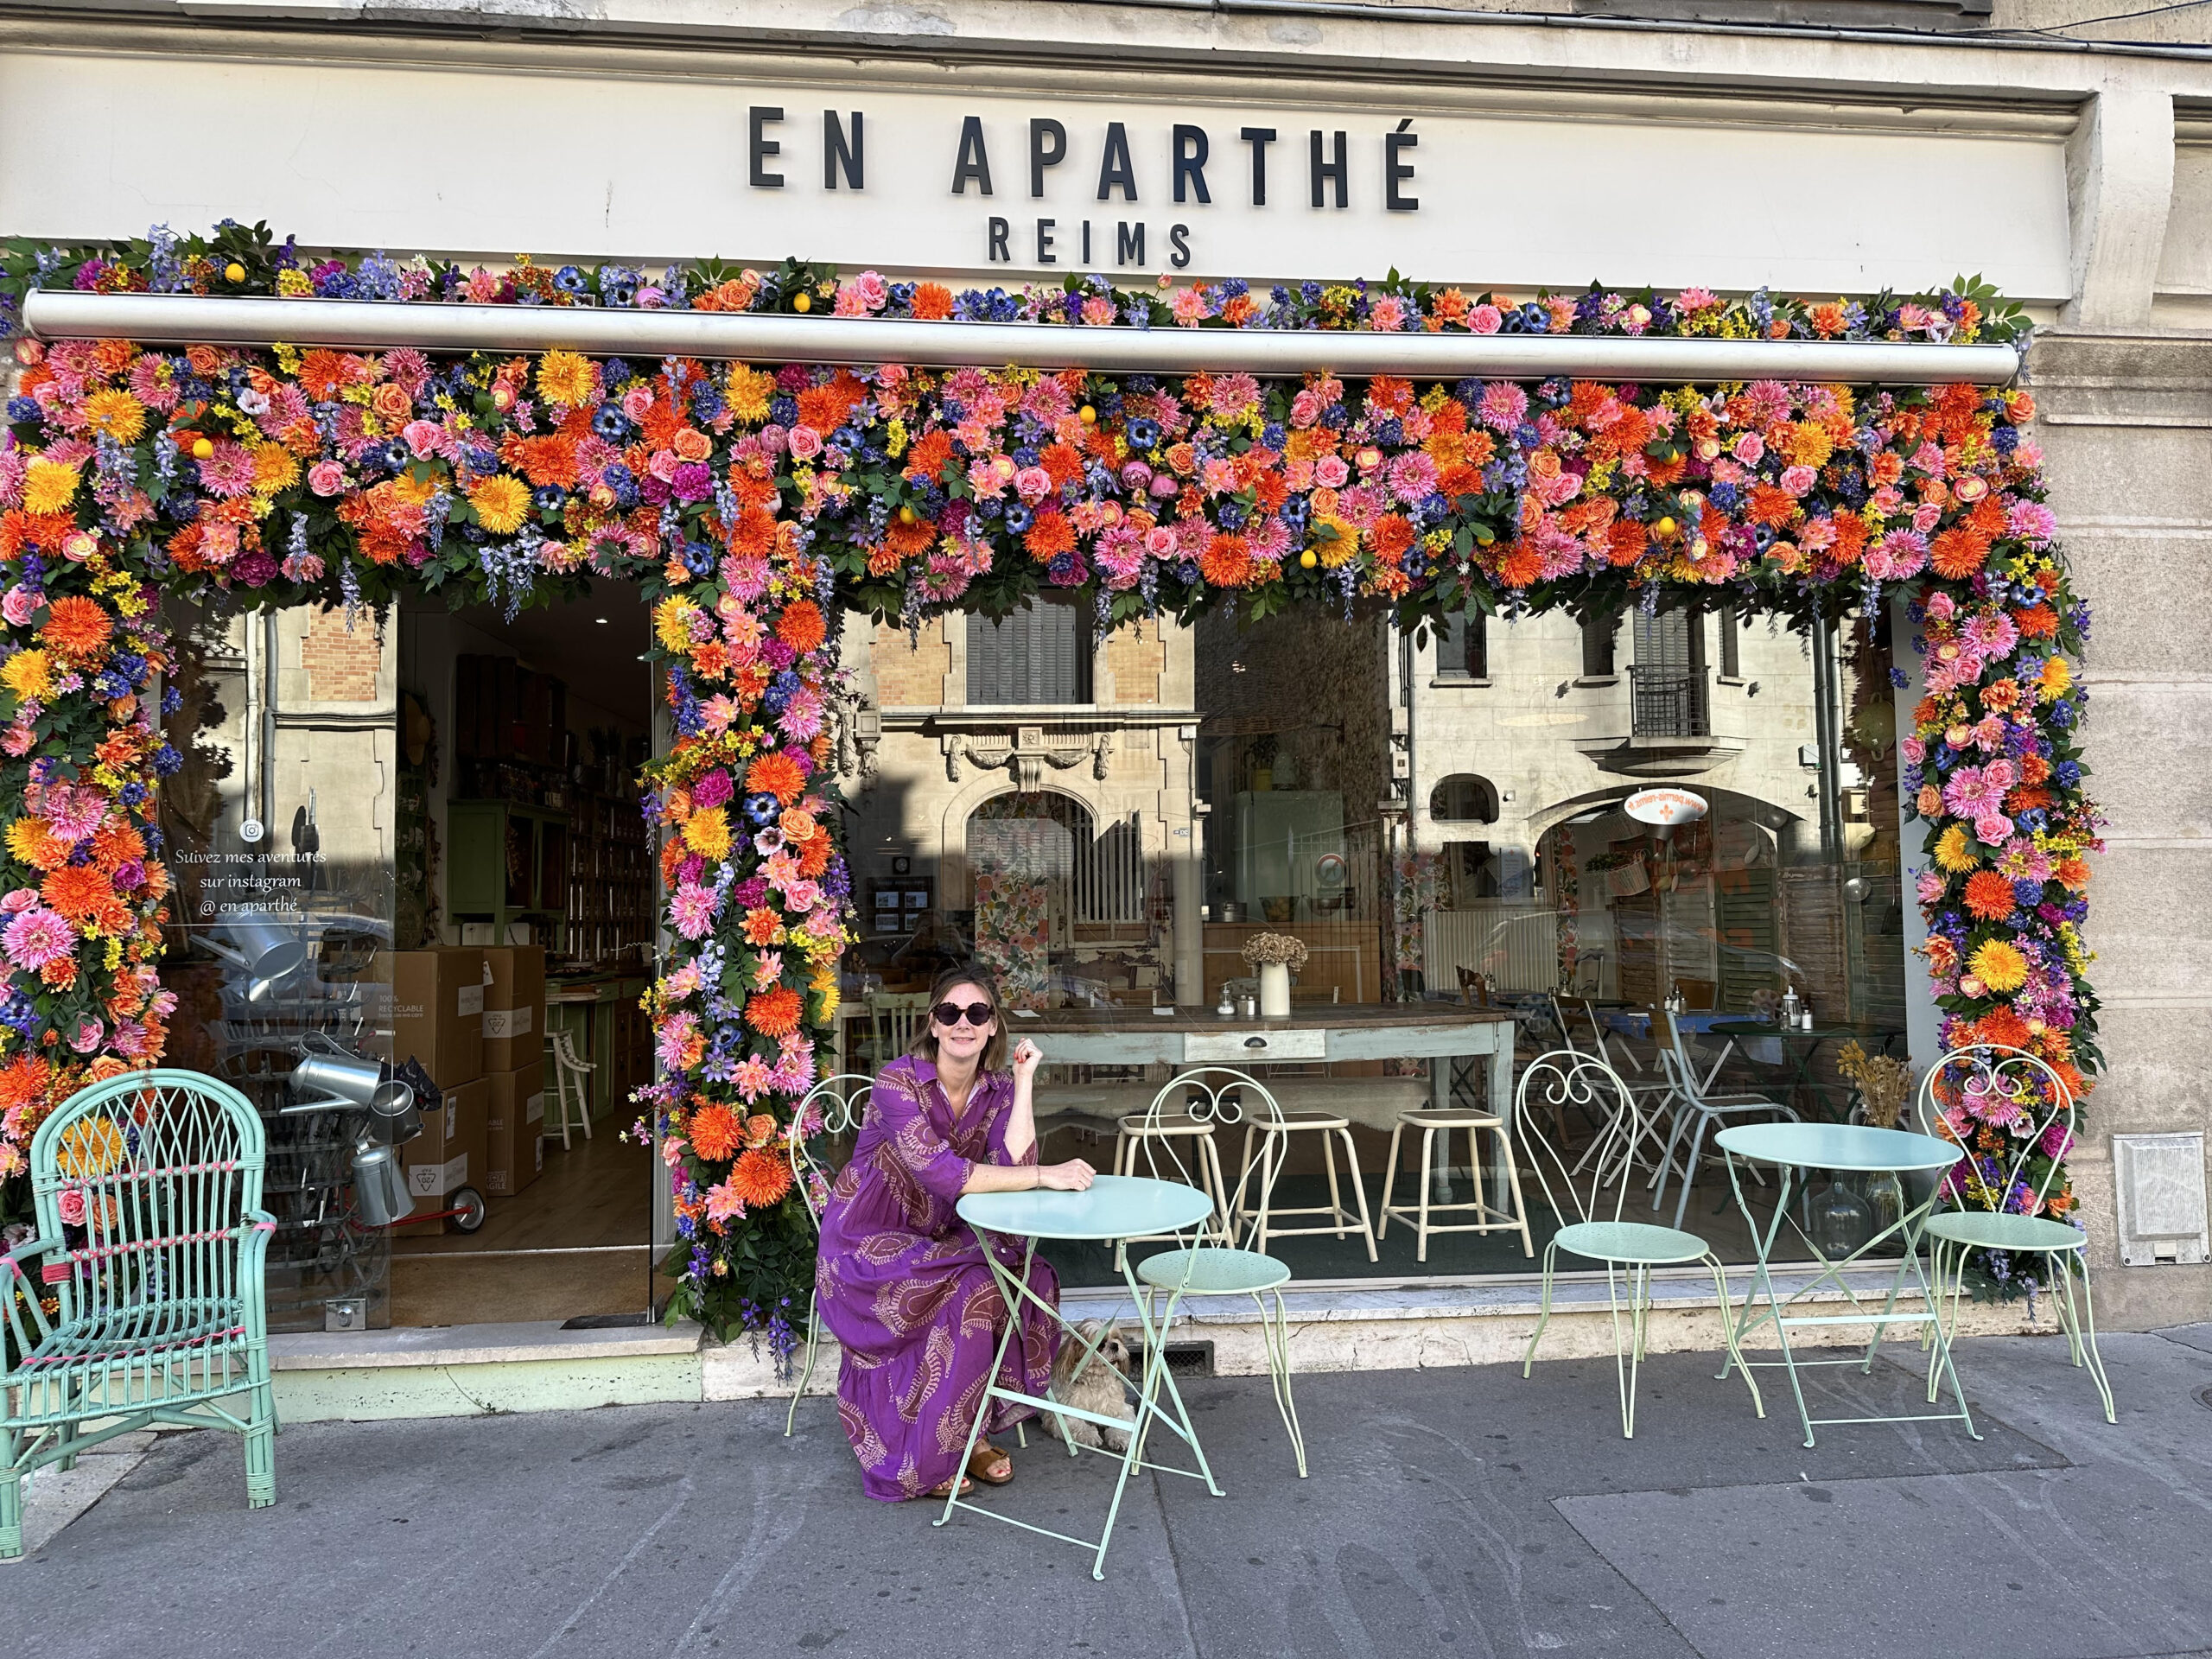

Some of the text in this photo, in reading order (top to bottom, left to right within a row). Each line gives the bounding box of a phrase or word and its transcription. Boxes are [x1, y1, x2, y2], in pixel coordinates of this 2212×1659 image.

[749, 106, 1418, 211] EN APARTHÉ
[988, 216, 1191, 268] REIMS
[175, 849, 327, 864] Suivez mes aventures
[200, 874, 302, 892] sur instagram
[200, 900, 216, 916] @
[379, 995, 399, 1003] 100%
